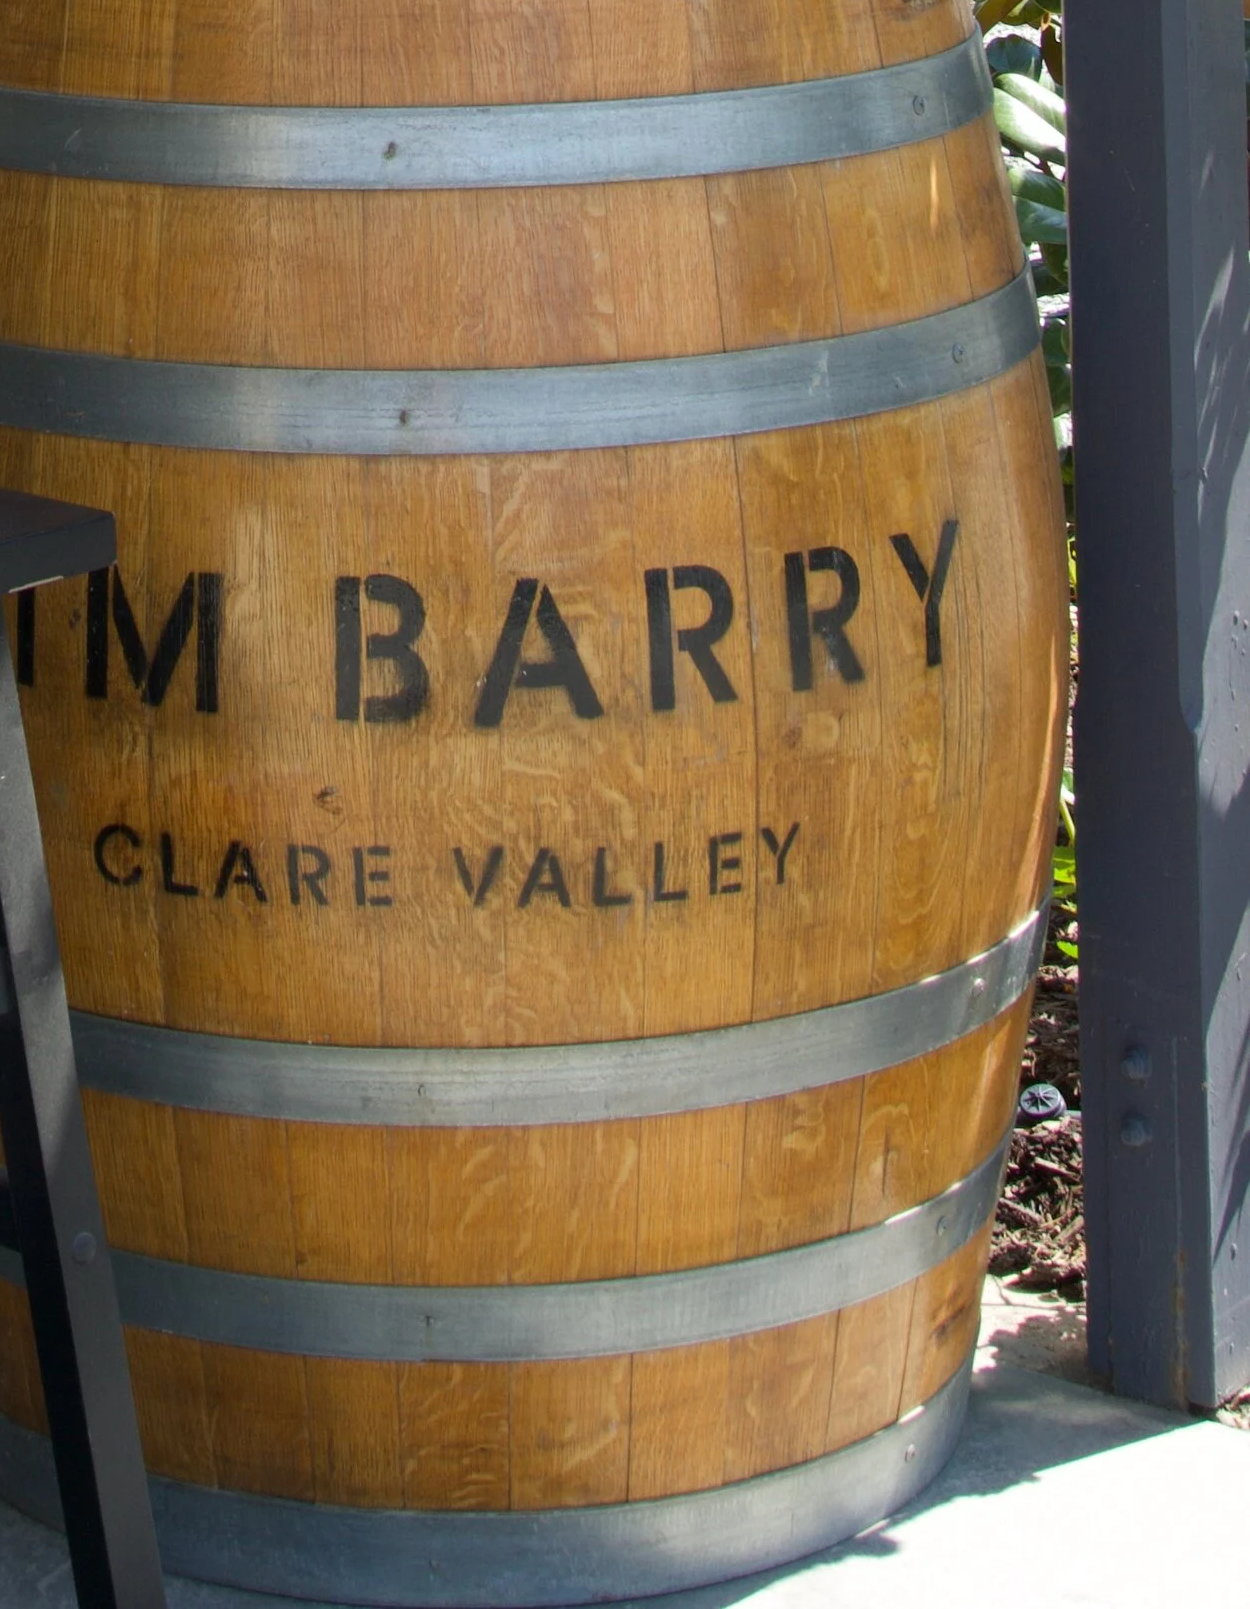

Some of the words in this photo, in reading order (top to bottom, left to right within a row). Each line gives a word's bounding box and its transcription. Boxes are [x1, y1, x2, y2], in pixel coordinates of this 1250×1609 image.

[17, 559, 225, 713] IM
[334, 519, 958, 729] BARRY
[93, 823, 394, 908] CLARE
[452, 822, 801, 908] VALLEY
